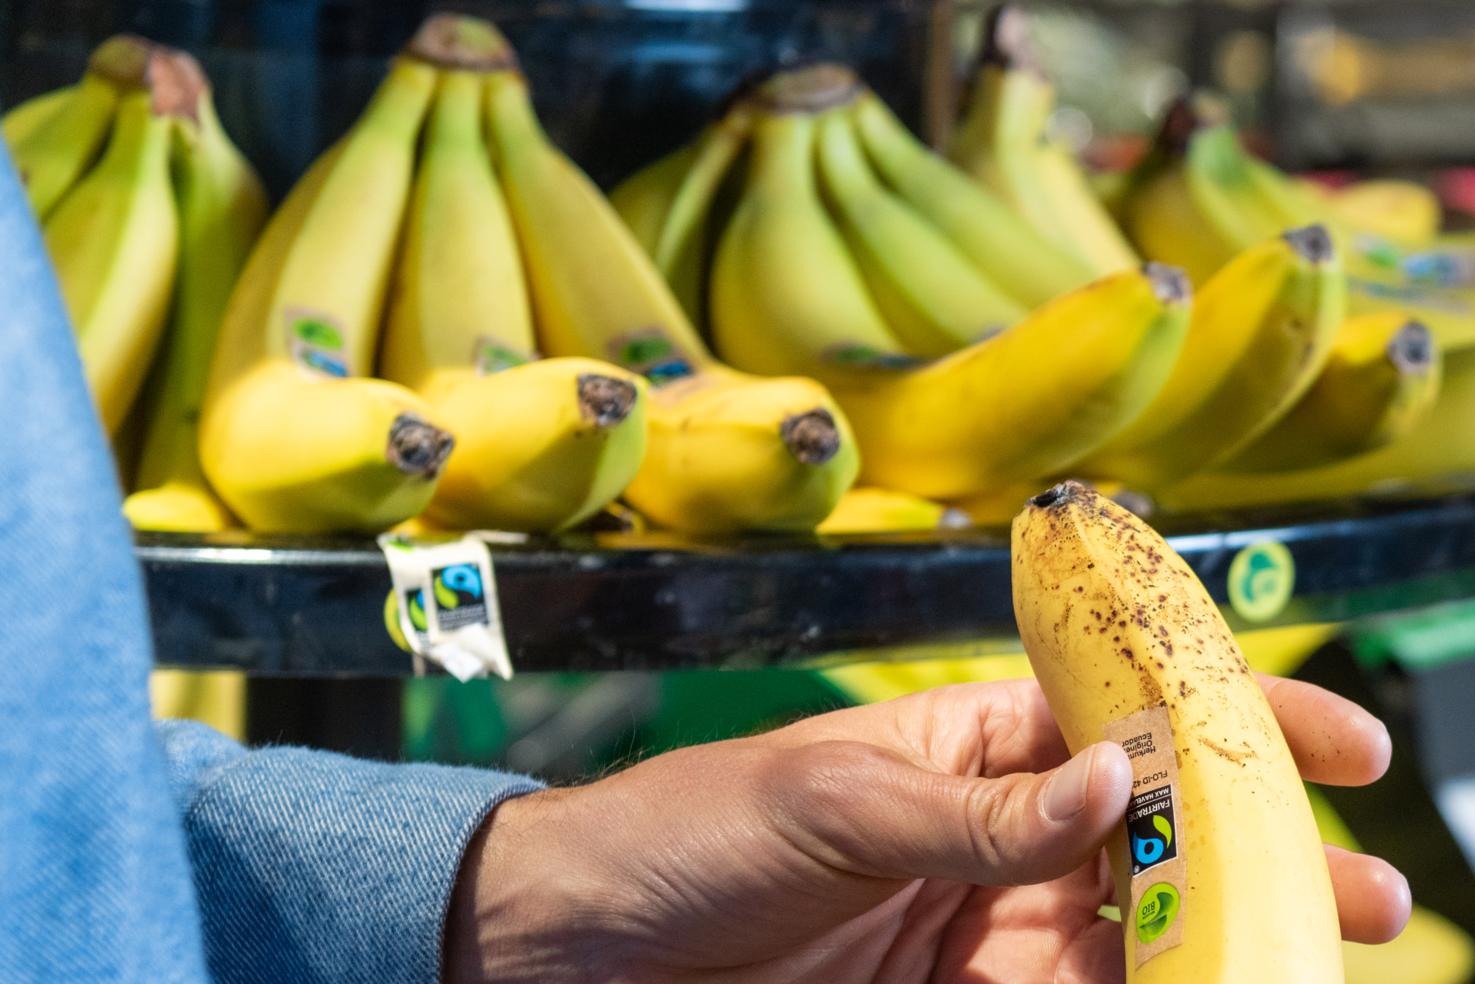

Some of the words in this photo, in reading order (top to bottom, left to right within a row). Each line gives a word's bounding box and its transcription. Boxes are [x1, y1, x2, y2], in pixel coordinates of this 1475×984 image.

[1122, 732, 1152, 747] Ecuador
[1142, 770, 1168, 785] FLO-ID
[1155, 788, 1170, 798] MAX
[1128, 799, 1170, 822] FAIRTRADE
[1142, 901, 1155, 915] BIO
